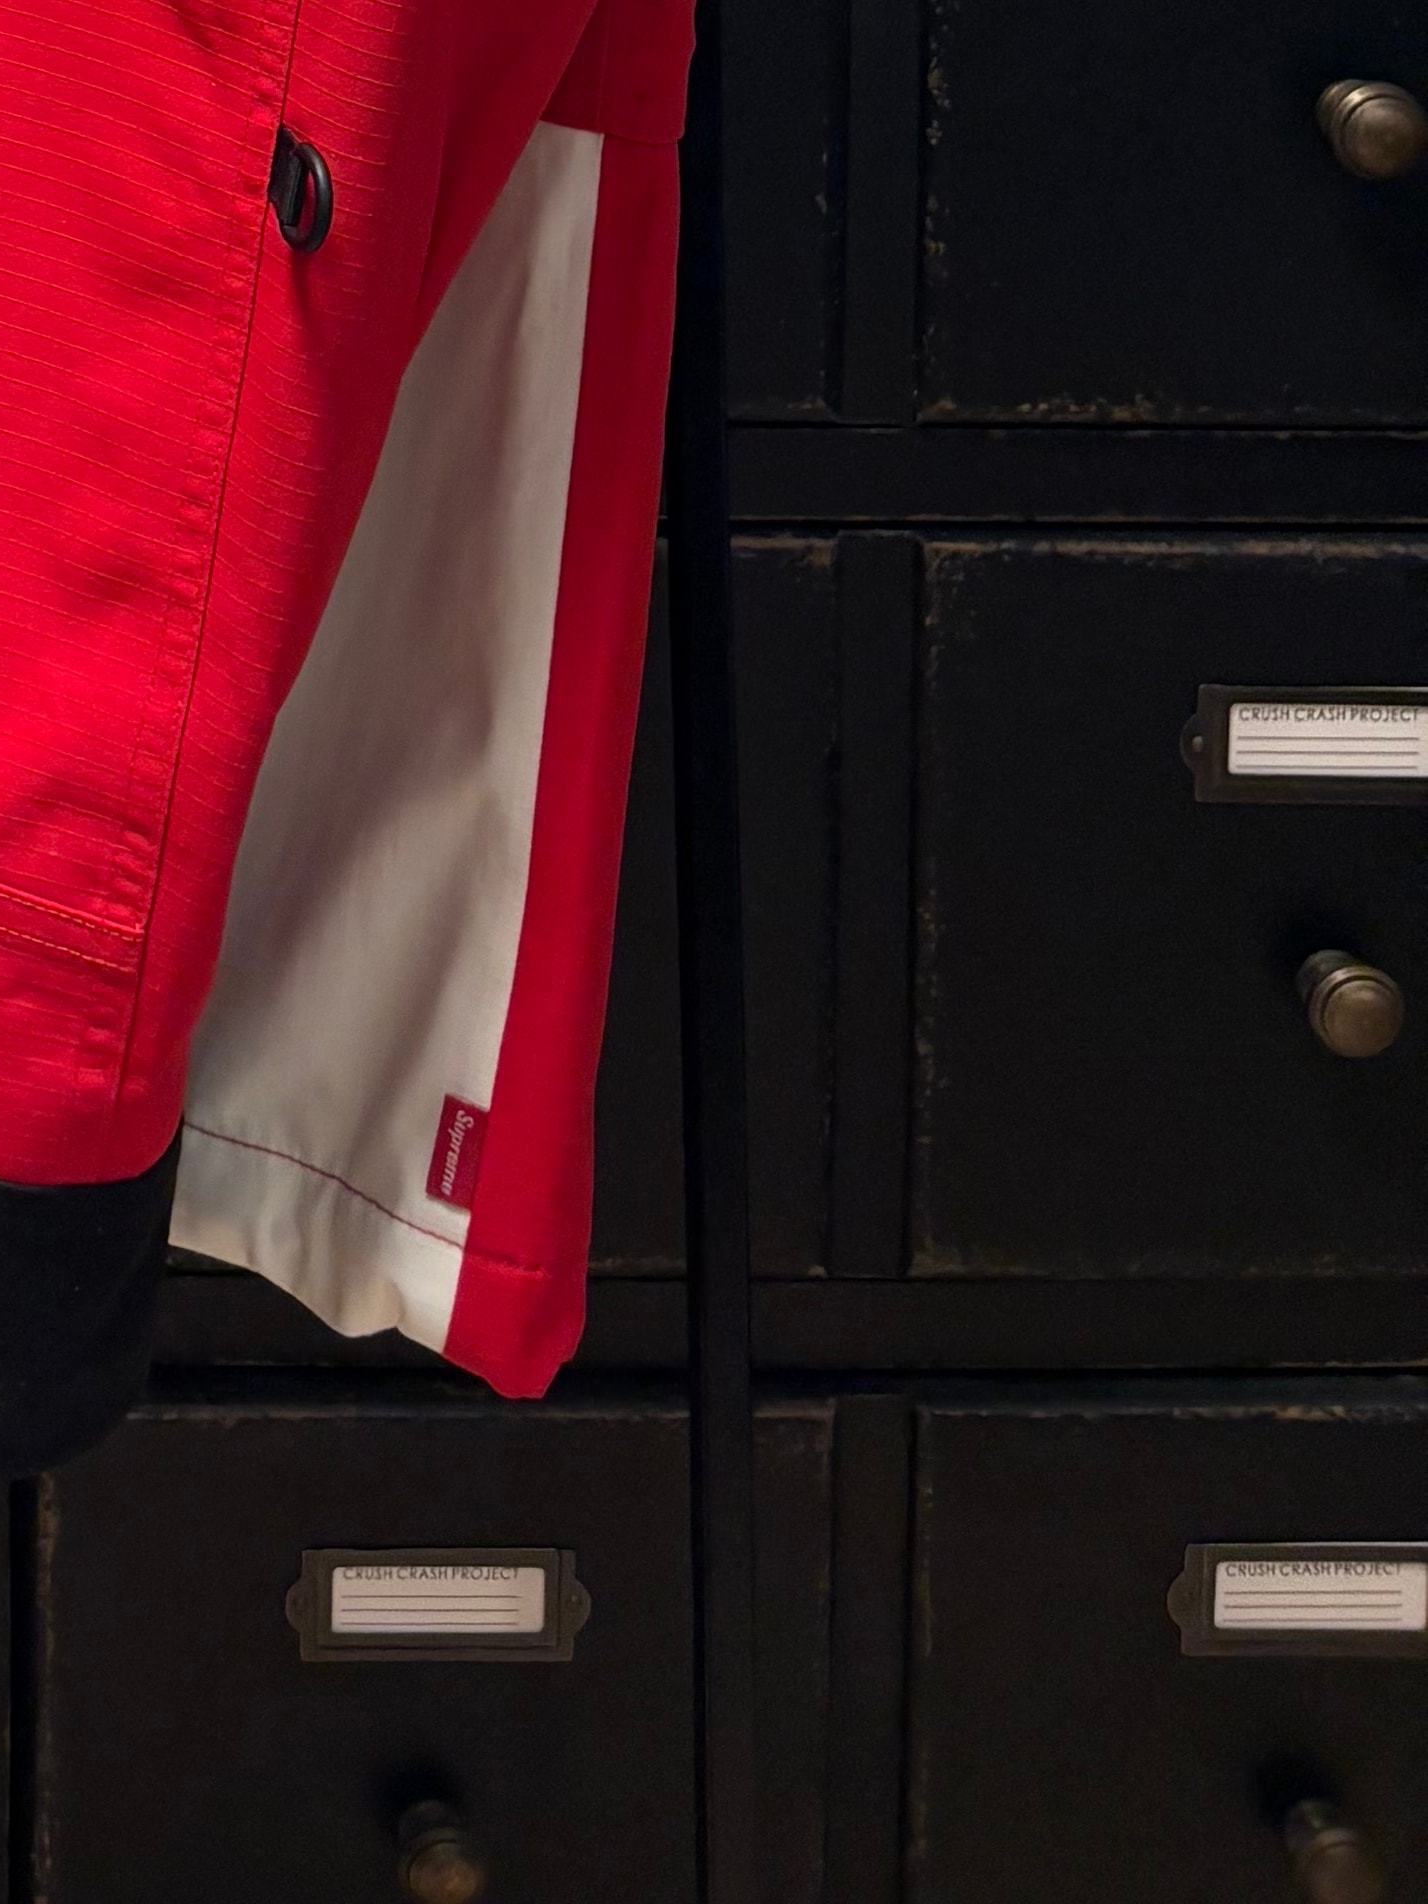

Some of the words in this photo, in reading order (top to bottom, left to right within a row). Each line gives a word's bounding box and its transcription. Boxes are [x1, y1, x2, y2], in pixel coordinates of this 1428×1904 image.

[1238, 707, 1290, 722] CRUSH
[1295, 707, 1346, 722] CRASH
[1350, 707, 1419, 722] PROJECT
[441, 1110, 474, 1195] Supreme
[343, 1567, 393, 1581] CRUSH
[397, 1567, 448, 1581] CRASH
[451, 1567, 519, 1581] PROJECT
[1226, 1563, 1276, 1577] CRUSH
[1279, 1563, 1333, 1577] CRASH
[1334, 1562, 1402, 1577] PROJECT
